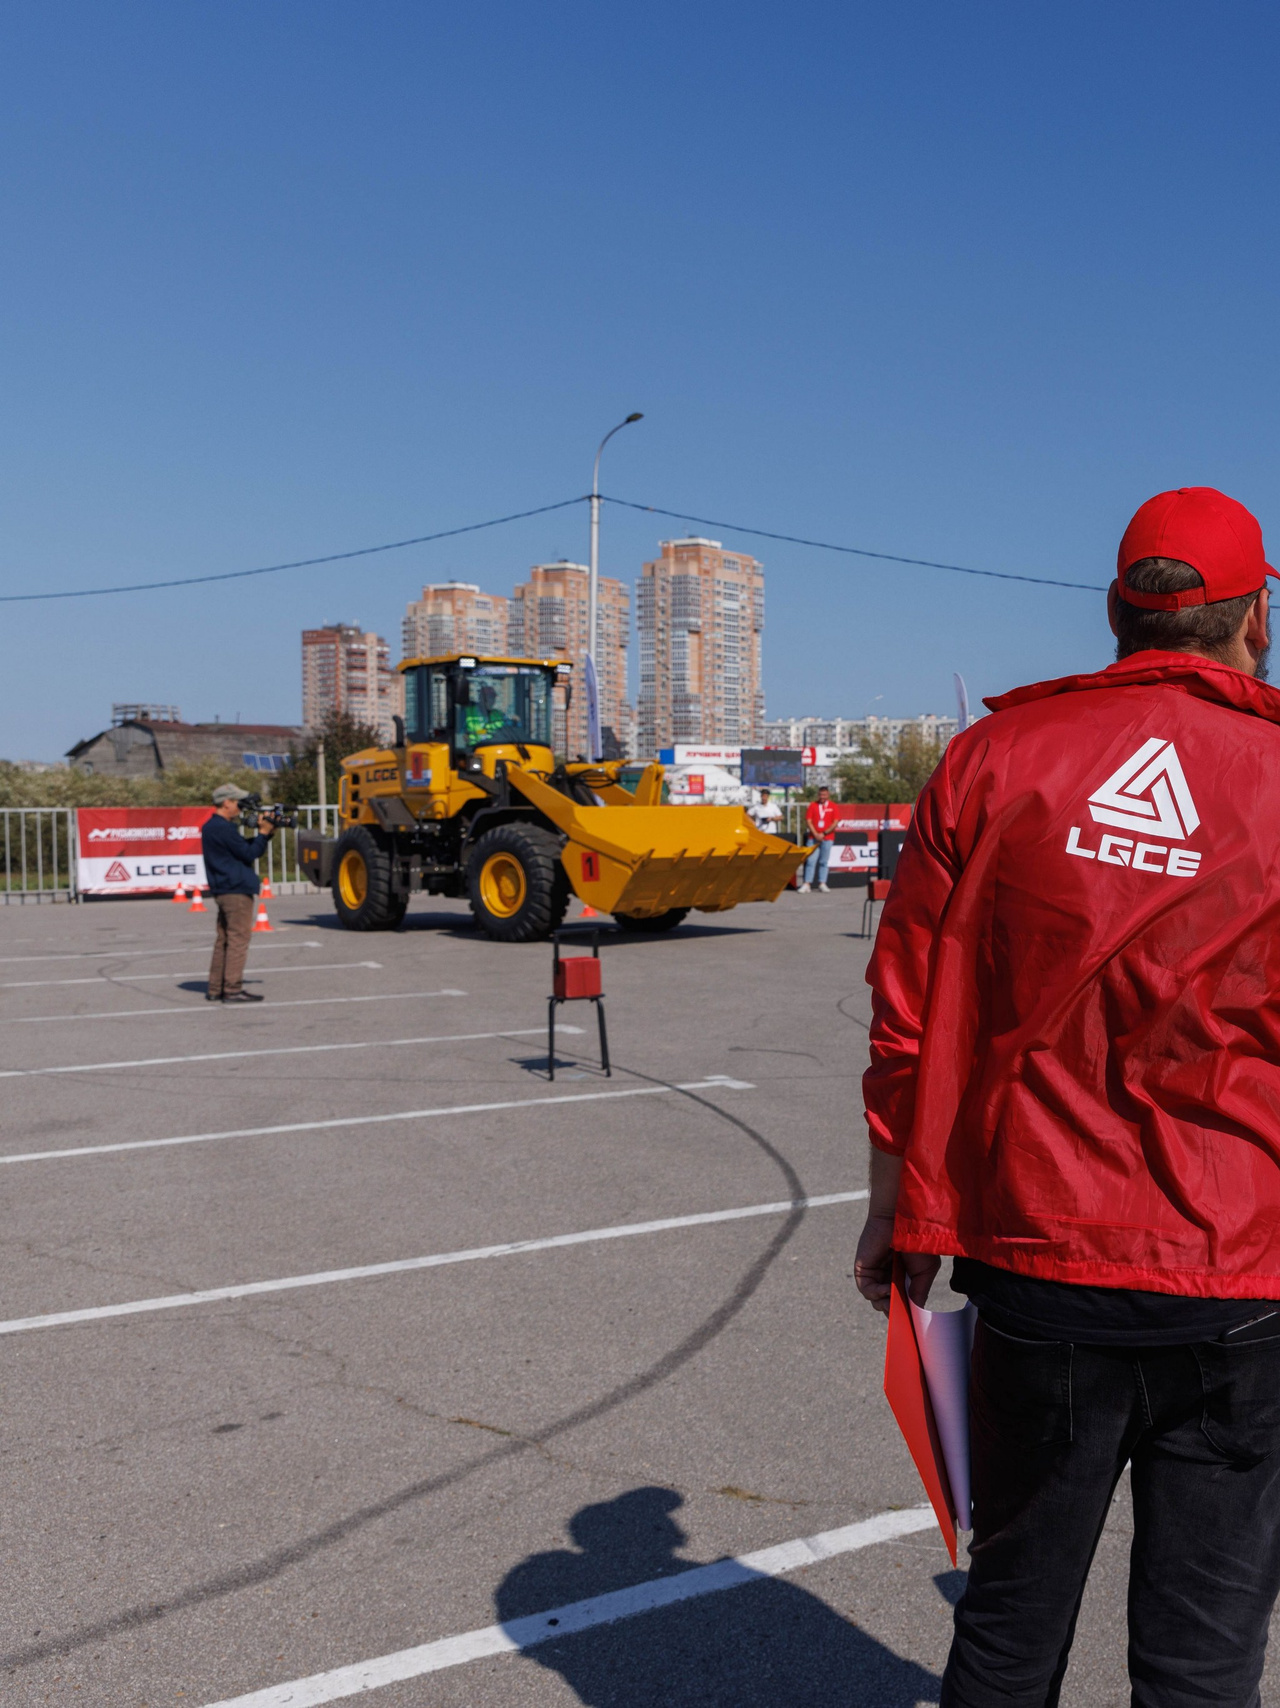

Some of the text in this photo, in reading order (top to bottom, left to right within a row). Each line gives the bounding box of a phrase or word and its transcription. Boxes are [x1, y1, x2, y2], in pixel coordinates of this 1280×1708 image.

[860, 849, 879, 858] LG
[1065, 826, 1202, 877] LGCE
[136, 864, 196, 876] LGCE
[585, 856, 594, 877] 1
